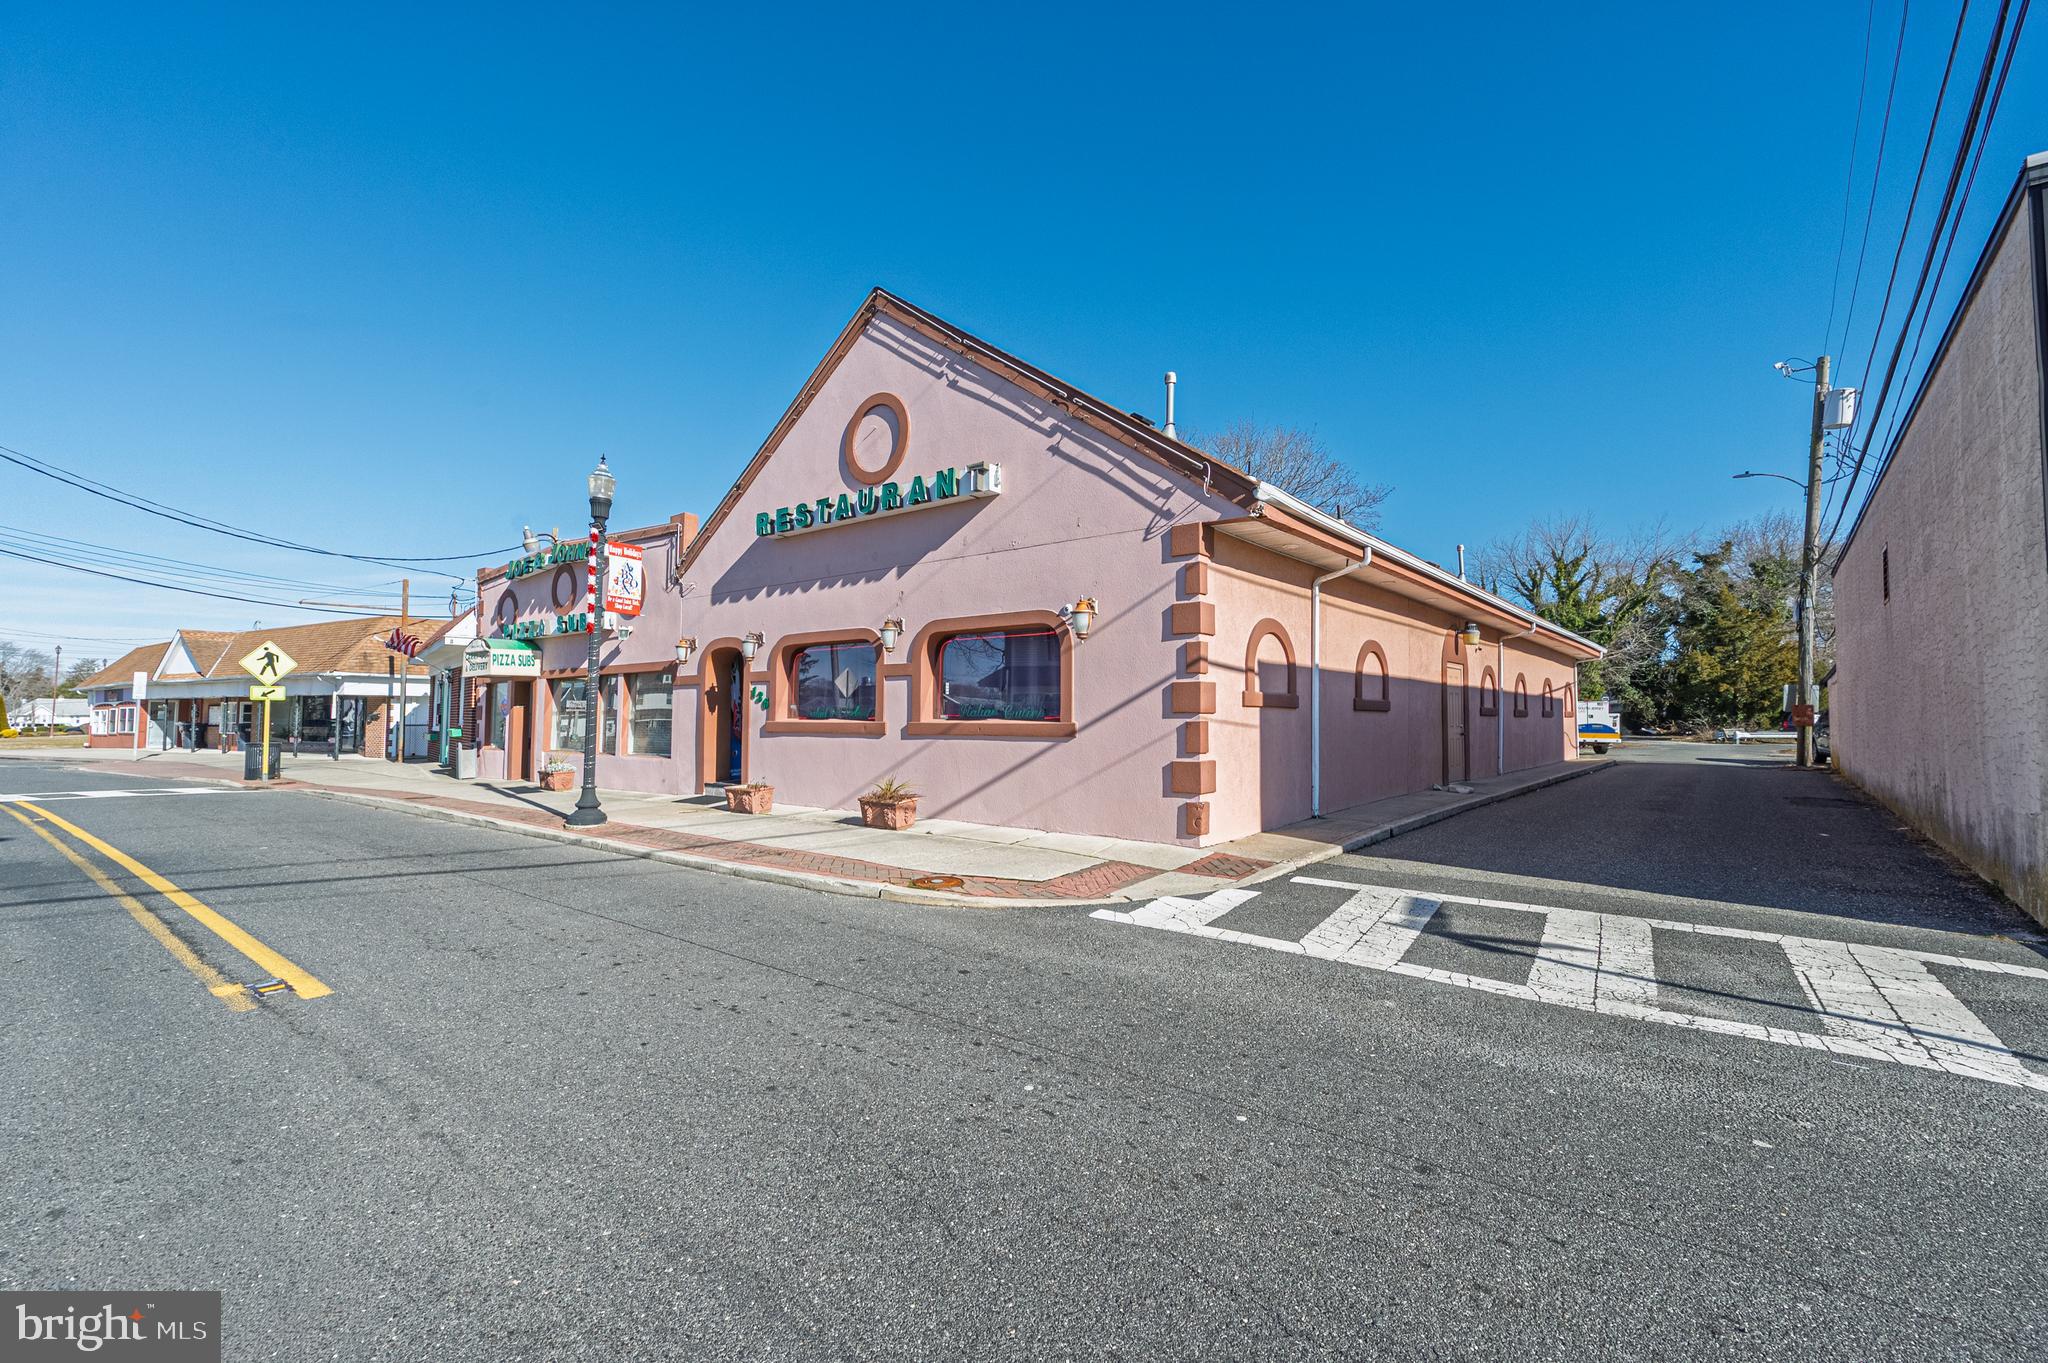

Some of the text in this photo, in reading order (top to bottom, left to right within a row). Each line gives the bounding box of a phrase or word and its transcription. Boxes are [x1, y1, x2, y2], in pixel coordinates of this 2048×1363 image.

[505, 556, 534, 580] JOE
[548, 543, 590, 564] JOHN
[608, 544, 642, 559] Happy Holidays
[503, 612, 588, 640] PIZZA SUB
[492, 653, 516, 666] PIZZA
[517, 654, 536, 667] SUBS
